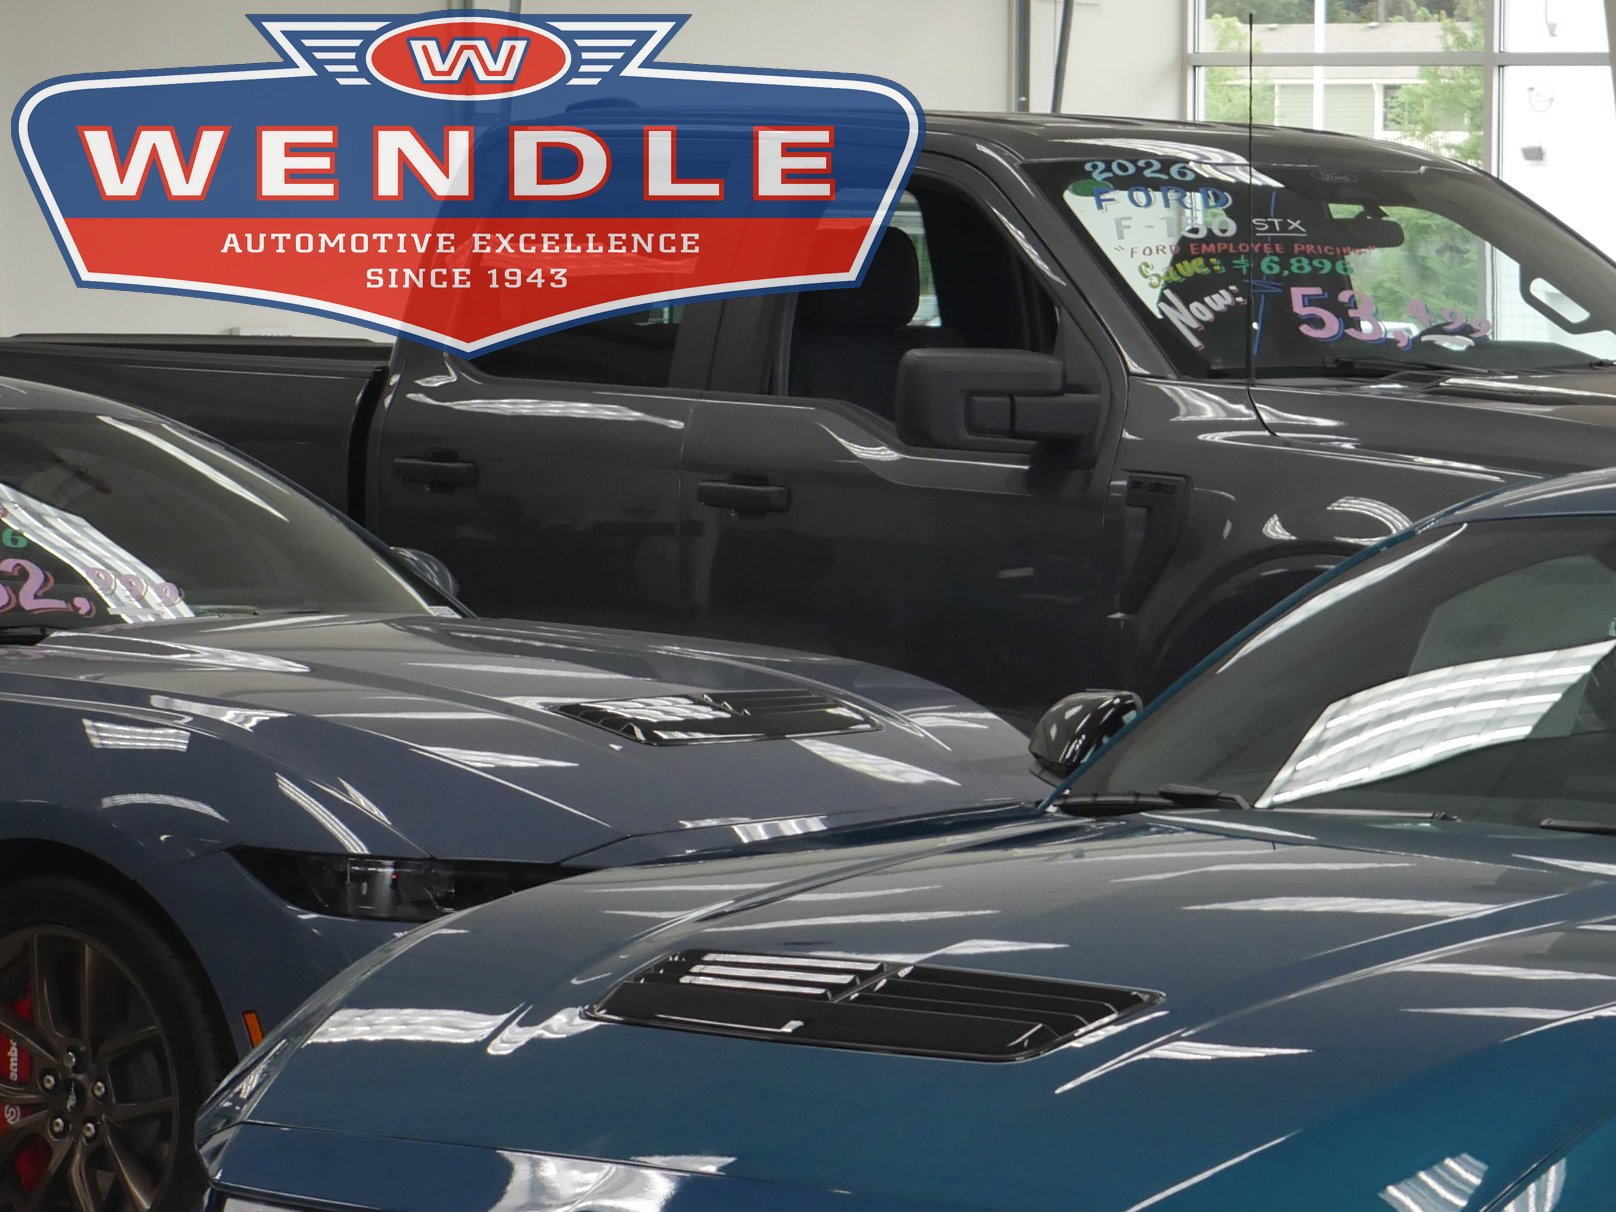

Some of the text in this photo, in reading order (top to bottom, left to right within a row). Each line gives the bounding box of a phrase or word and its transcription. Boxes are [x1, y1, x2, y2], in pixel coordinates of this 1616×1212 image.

[1084, 159, 1196, 182] 2026
[1092, 185, 1232, 212] FORD
[1114, 215, 1307, 240] F-150 STX
[1189, 242, 1285, 255] EMPLOYEE
[1157, 284, 1248, 350] Now:
